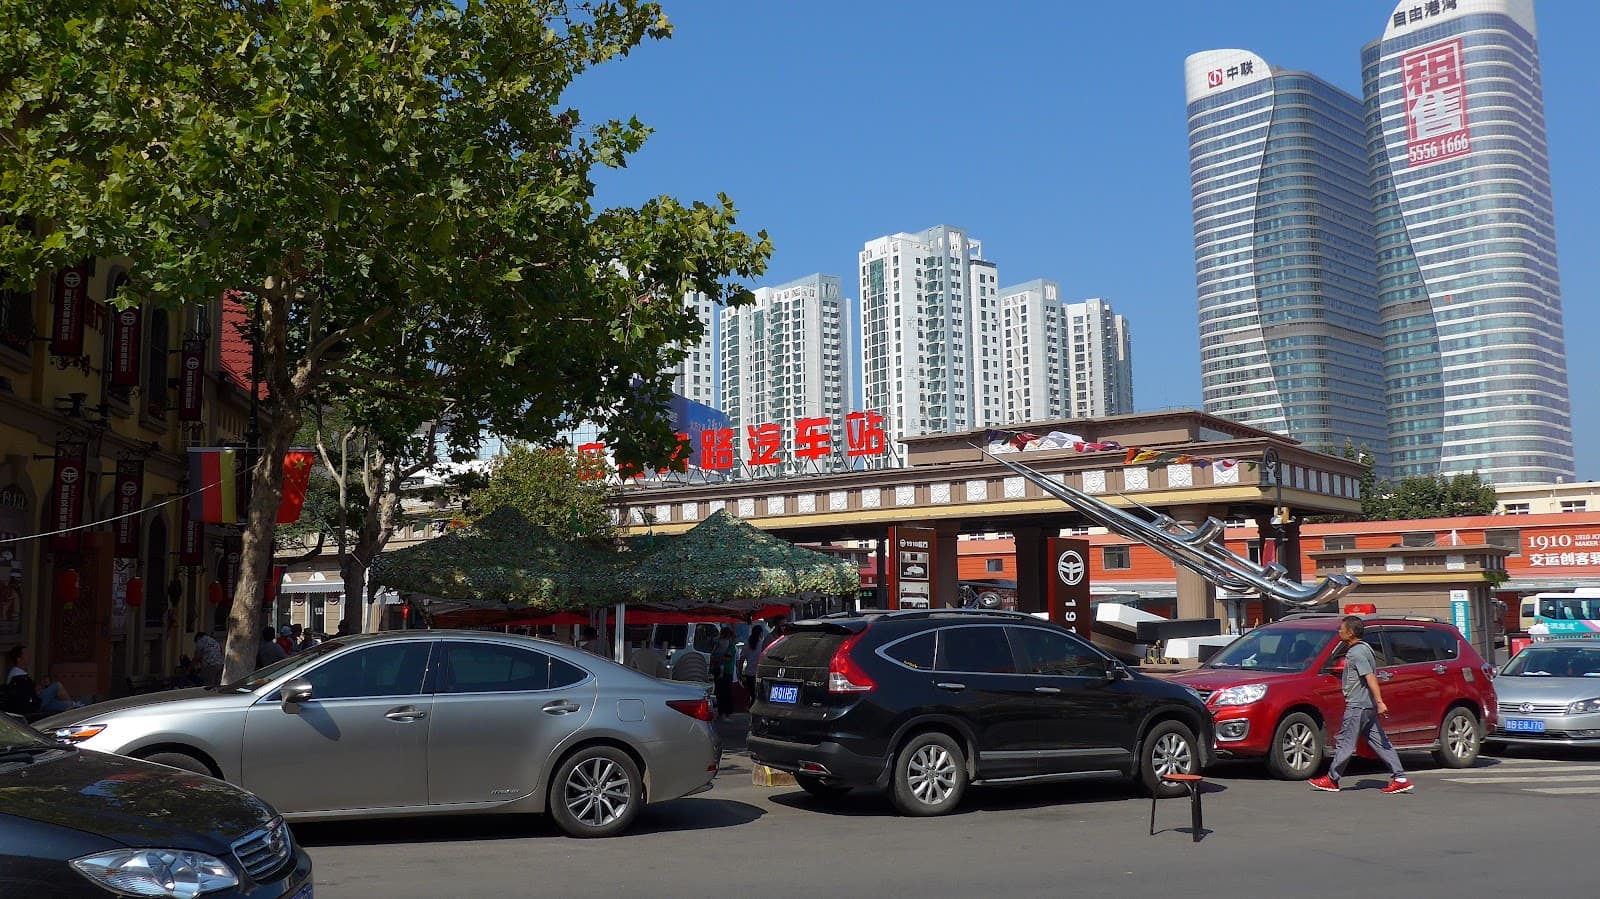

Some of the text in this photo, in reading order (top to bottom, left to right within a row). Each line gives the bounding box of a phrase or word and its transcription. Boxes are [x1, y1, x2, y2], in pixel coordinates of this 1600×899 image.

[1226, 59, 1253, 80] 中联
[1409, 133, 1469, 163] 5556 1666
[1528, 534, 1571, 551] 1910
